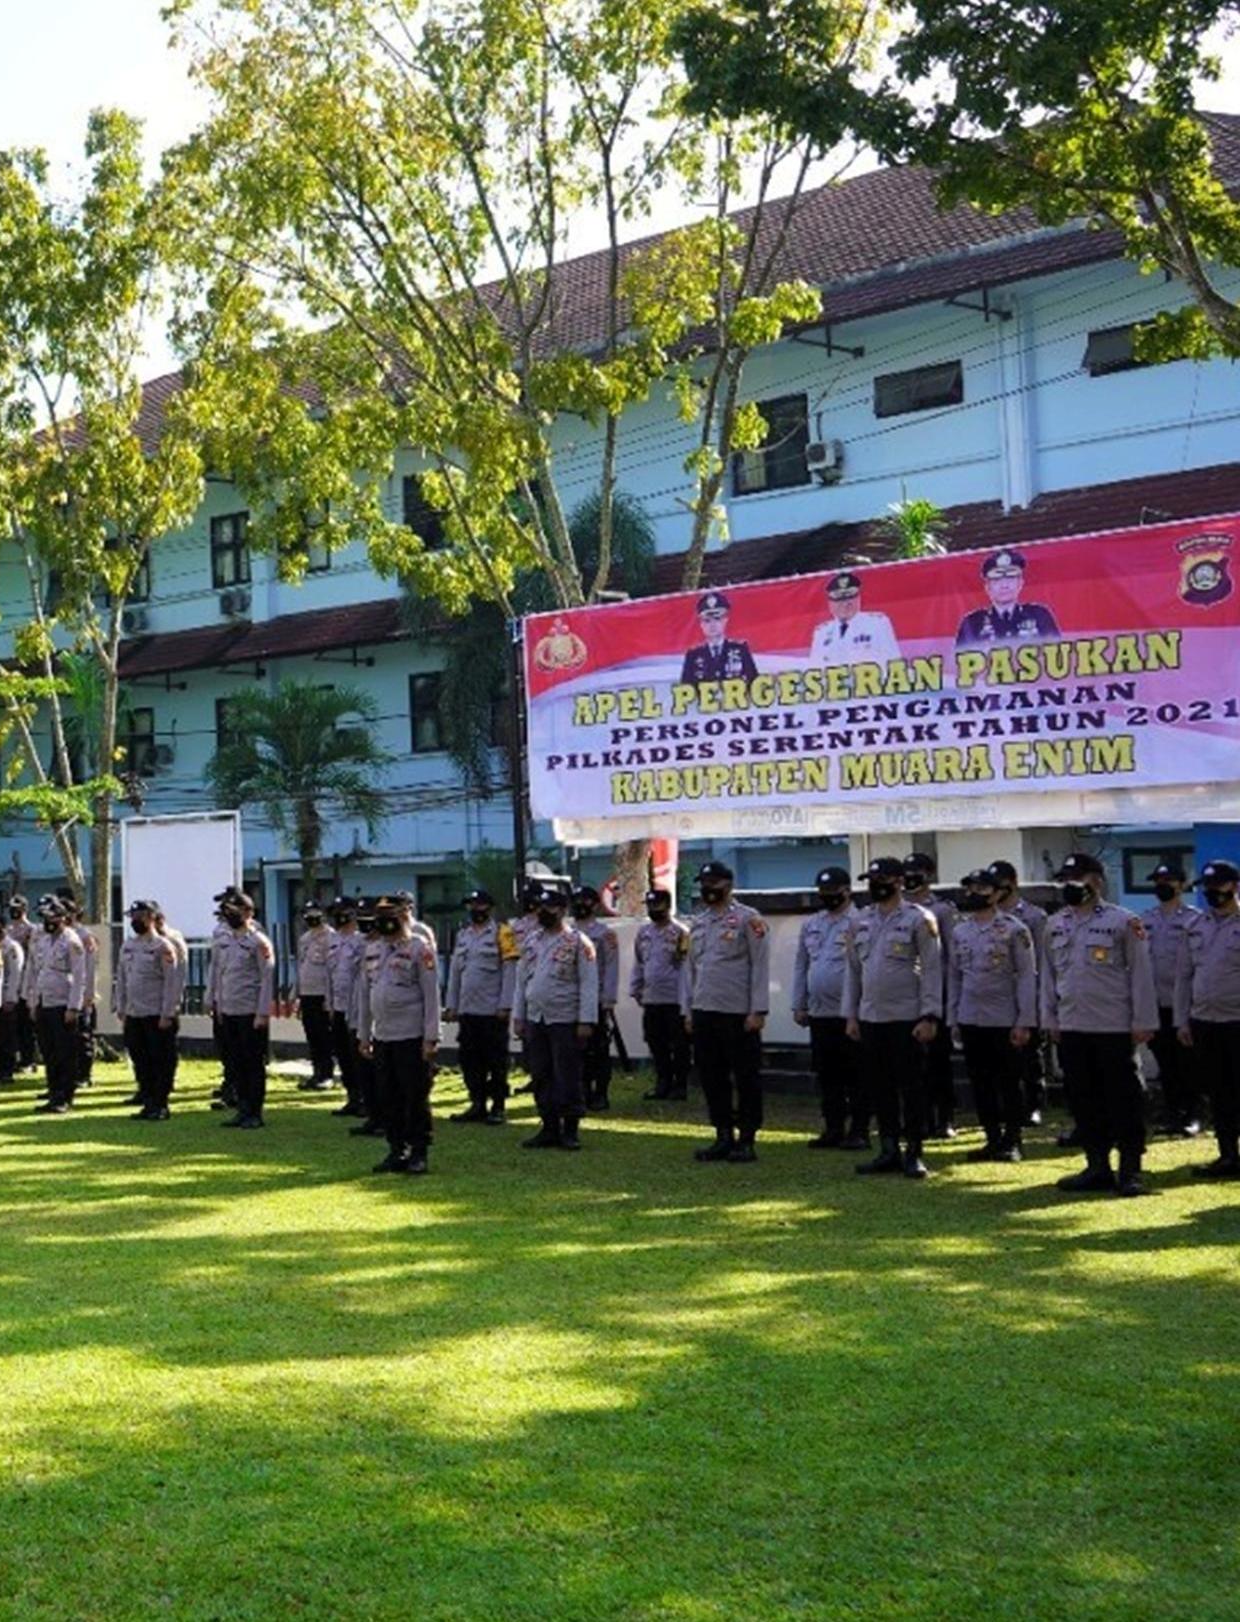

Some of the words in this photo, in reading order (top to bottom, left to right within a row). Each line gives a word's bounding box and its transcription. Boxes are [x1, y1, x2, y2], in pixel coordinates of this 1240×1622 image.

[573, 689, 662, 724] APEL
[672, 656, 942, 714] PERGESERAN
[956, 631, 1181, 687] PASUKAN
[547, 743, 715, 770] PILKADES
[728, 726, 939, 755] SERENTAK
[953, 711, 1106, 738] TAHUN
[1127, 699, 1239, 725] 2021
[611, 714, 803, 743] PERSONEL
[818, 683, 1136, 724] PENGAMANAN
[611, 758, 828, 803] KABUPATEN
[841, 745, 994, 787] MUARA
[1004, 736, 1135, 778] ENIM
